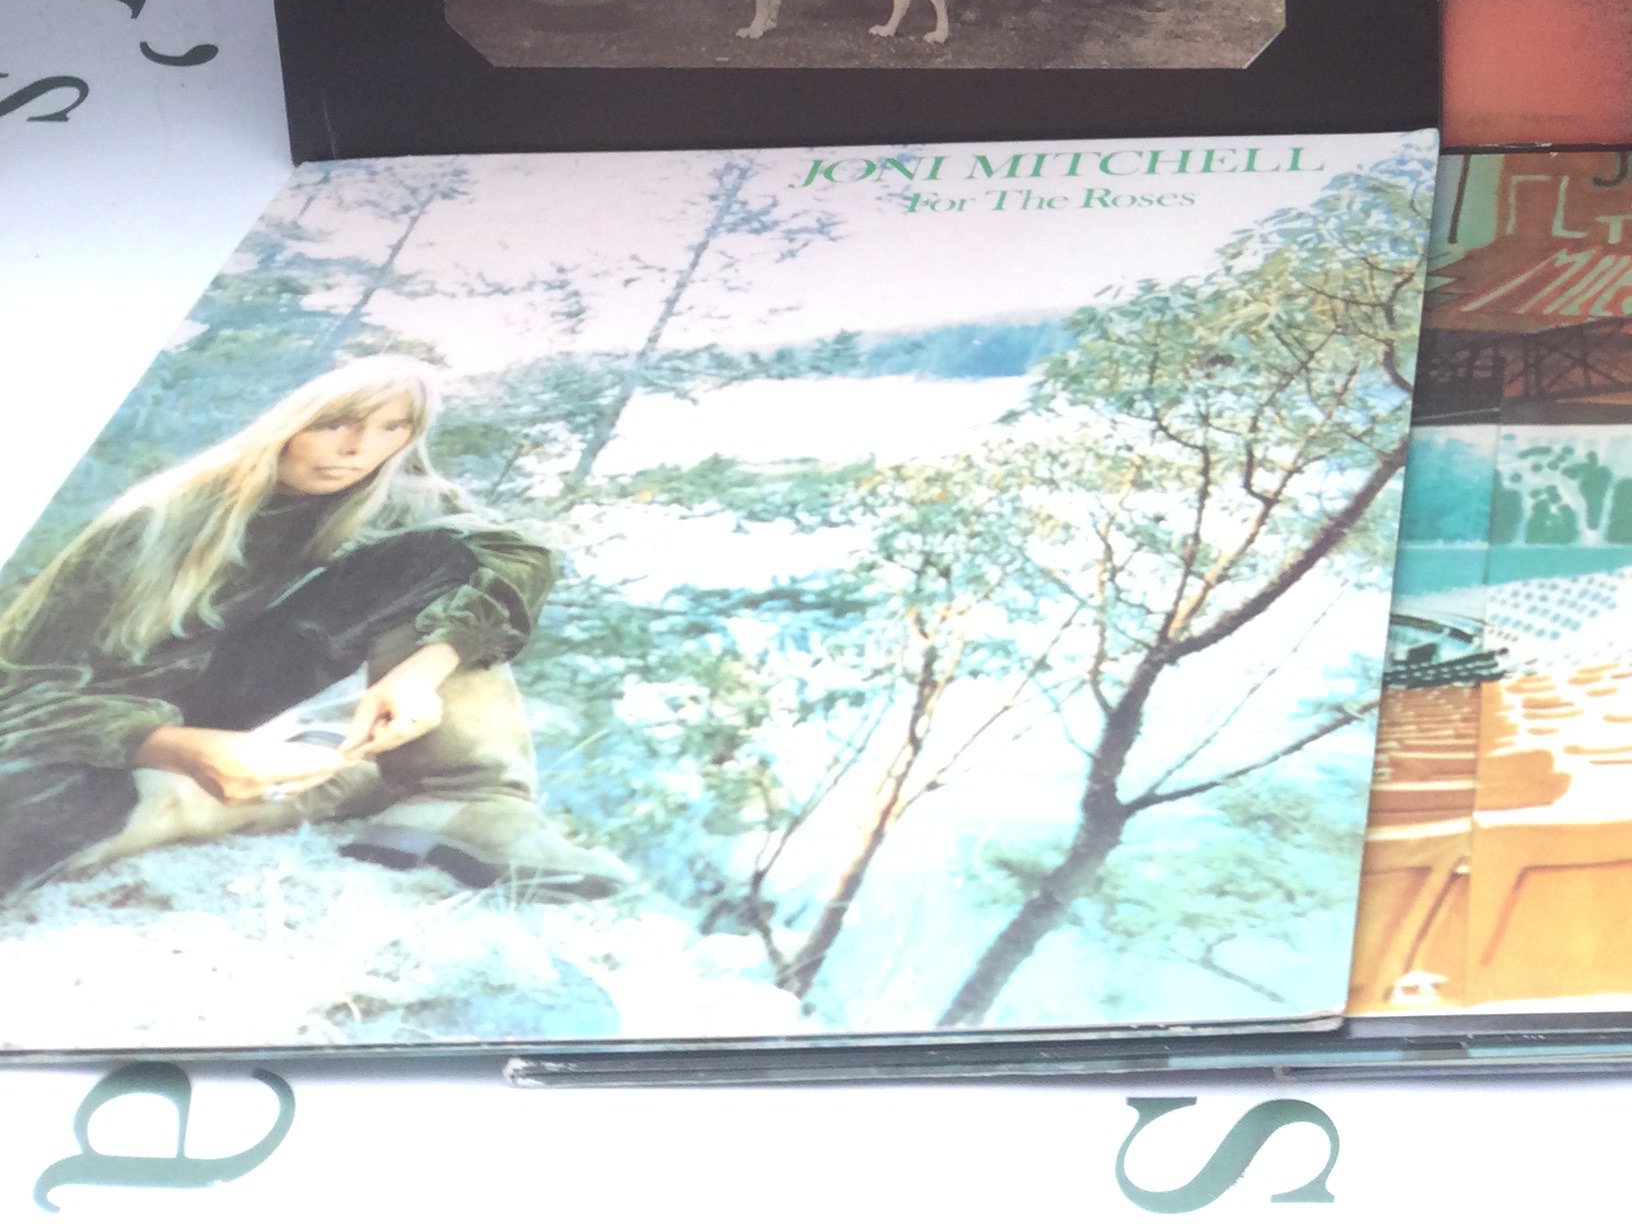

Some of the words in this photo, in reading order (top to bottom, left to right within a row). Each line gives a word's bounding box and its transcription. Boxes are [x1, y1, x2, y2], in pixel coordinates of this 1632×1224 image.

[789, 154, 944, 188] JONI
[966, 147, 1324, 181] MITCHELL
[905, 191, 969, 214] For
[990, 190, 1071, 212] The
[1079, 186, 1196, 209] Roses
